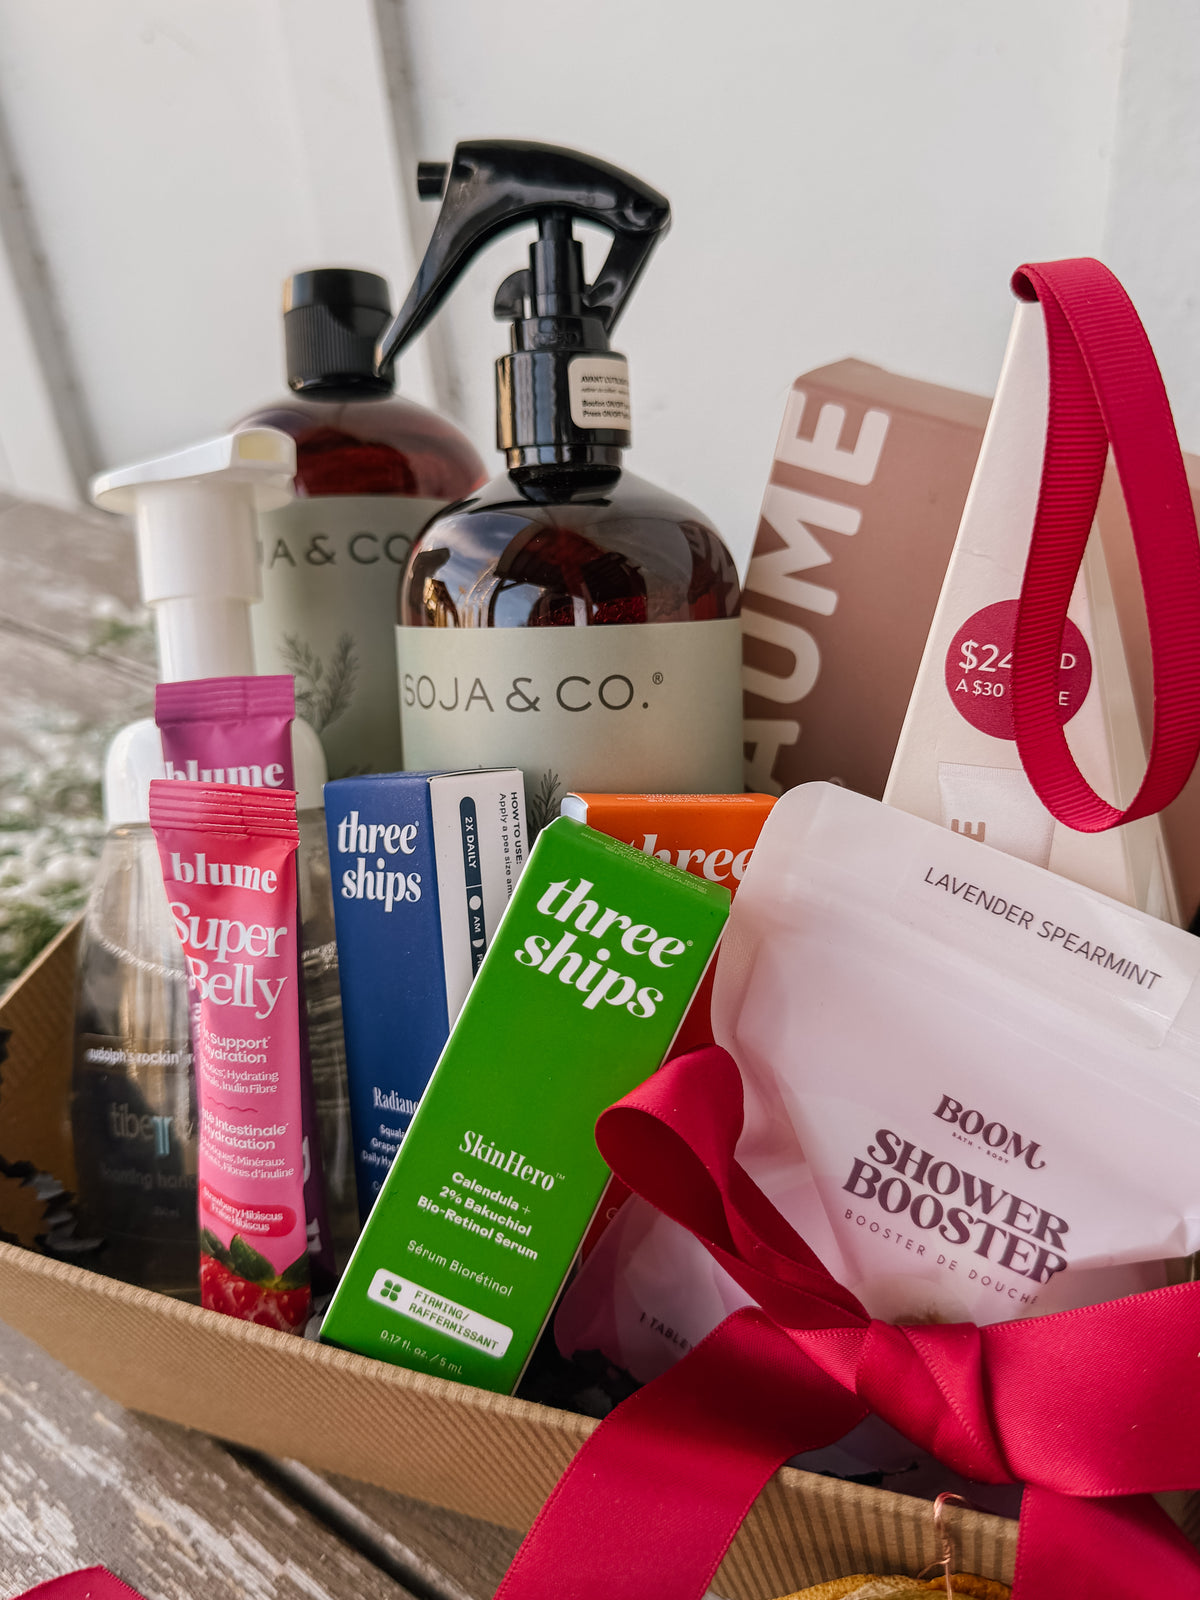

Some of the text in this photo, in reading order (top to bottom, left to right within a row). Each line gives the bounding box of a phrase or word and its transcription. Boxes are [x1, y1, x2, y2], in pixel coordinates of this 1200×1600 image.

[305, 534, 337, 567] &
[403, 673, 494, 713] SOJA
[505, 677, 541, 713] &
[955, 678, 1005, 698] A $30
[463, 816, 475, 832] 2X
[498, 792, 508, 823] Apply
[510, 791, 522, 865] HOW TO USE:
[466, 835, 477, 869] DAILY
[501, 834, 510, 853] pea
[628, 833, 754, 883] hree
[170, 852, 278, 894] blume
[341, 857, 422, 913] ships
[168, 902, 288, 963] Super
[473, 916, 481, 933] AM
[924, 866, 1162, 990] LAVENDER SPEARMINT
[185, 954, 289, 1020] Belly
[514, 931, 664, 1018] ships
[227, 1070, 280, 1083] Hydrating
[249, 1084, 278, 1094] Fibre
[371, 1137, 396, 1153] Grape
[932, 1093, 1046, 1170] BOOM
[439, 1185, 533, 1237] 2% Bakuchiol
[452, 1171, 520, 1212] Calendula
[867, 1128, 1070, 1252] SHOWER
[417, 1194, 539, 1261] Bio-Retinol Serum
[842, 1157, 1068, 1285] BOOSTER
[844, 1208, 926, 1256] BOOSTER
[936, 1254, 958, 1271] DE
[407, 1239, 514, 1297] Sérum Biorétinol
[408, 1302, 499, 1350] RAFFERMISSANT
[414, 1289, 470, 1321] FIRMING/
[650, 1317, 694, 1351] TABLE
